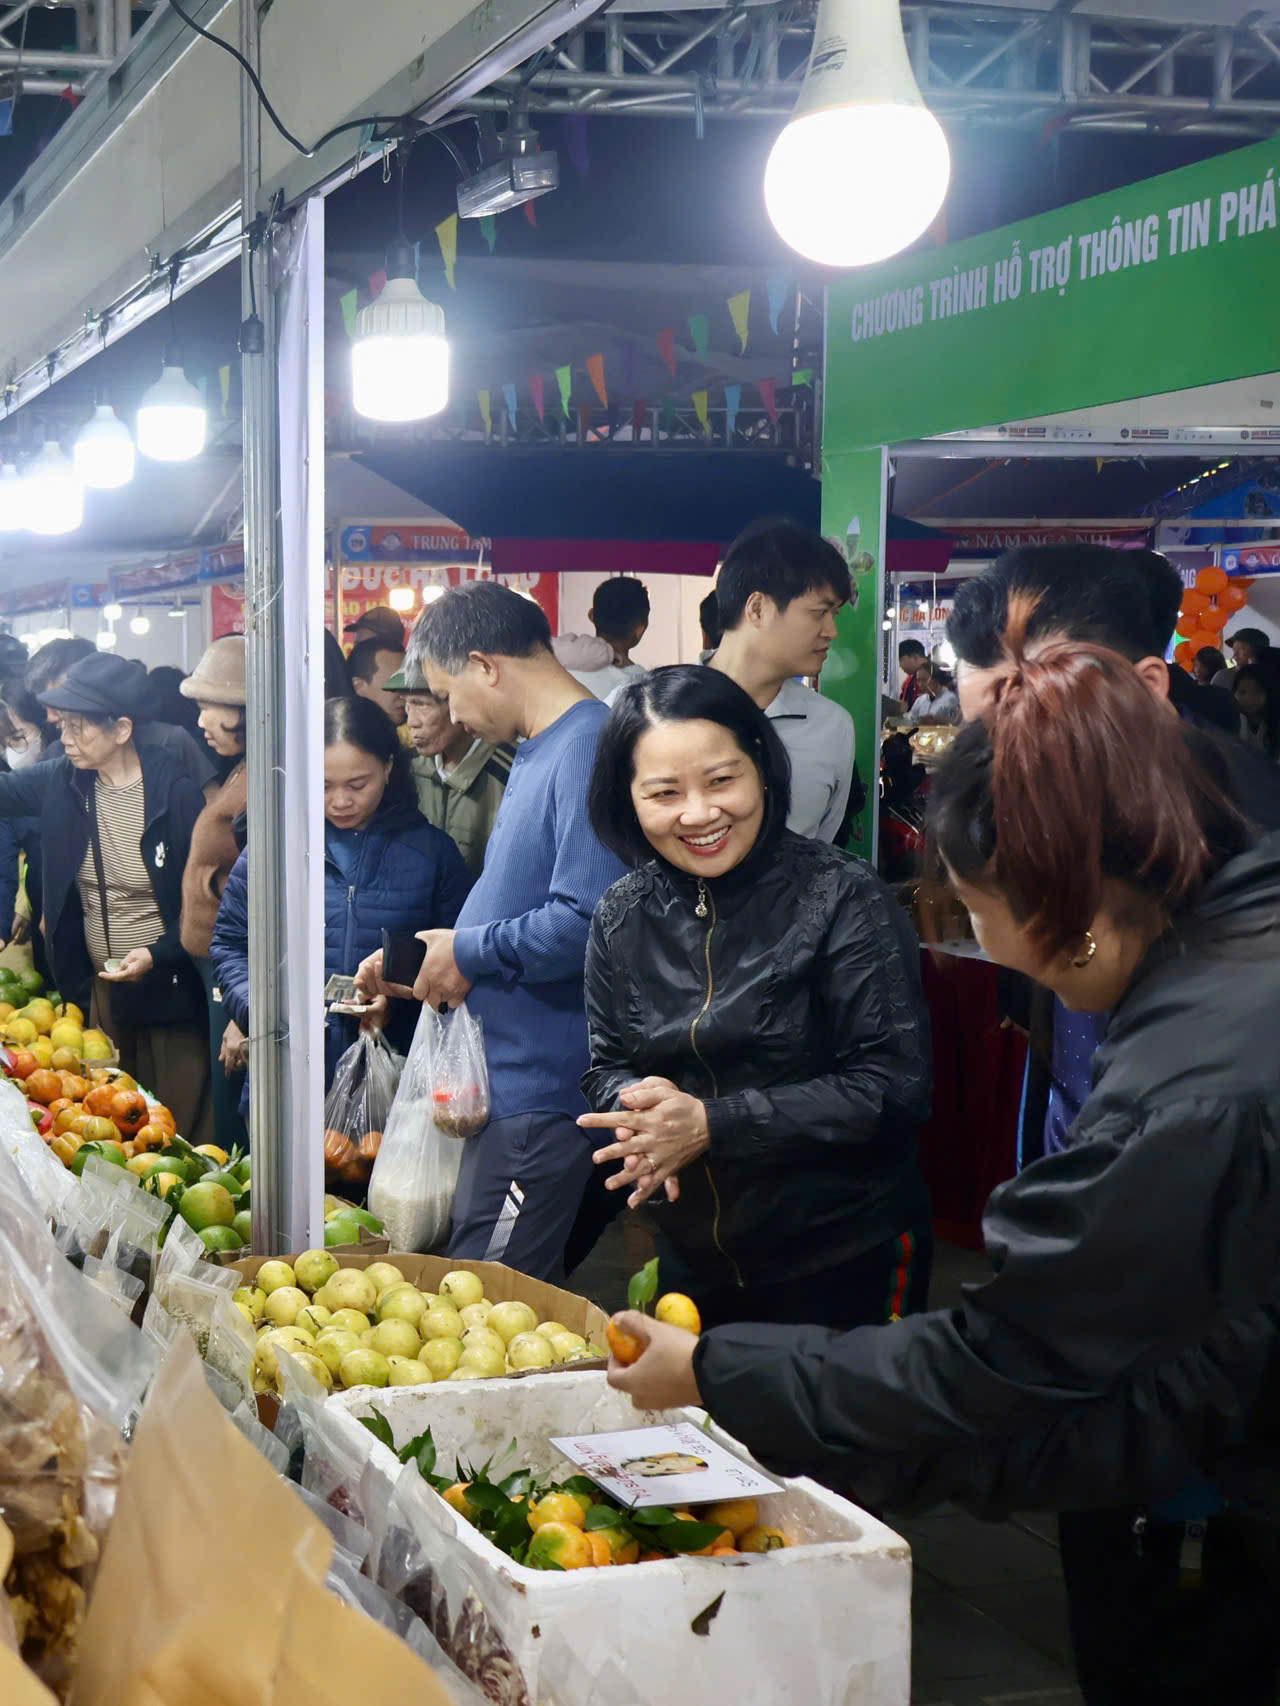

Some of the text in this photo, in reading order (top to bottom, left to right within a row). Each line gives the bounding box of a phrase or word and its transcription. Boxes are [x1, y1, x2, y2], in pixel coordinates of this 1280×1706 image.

[929, 265, 988, 320] TRÌNH
[993, 238, 1022, 305] HỖ
[1029, 234, 1073, 296] TRỢ
[1078, 214, 1160, 281] THÔNG
[1167, 198, 1211, 256] TIN
[1218, 167, 1280, 242] PHÁ
[413, 535, 460, 551] TRUNG
